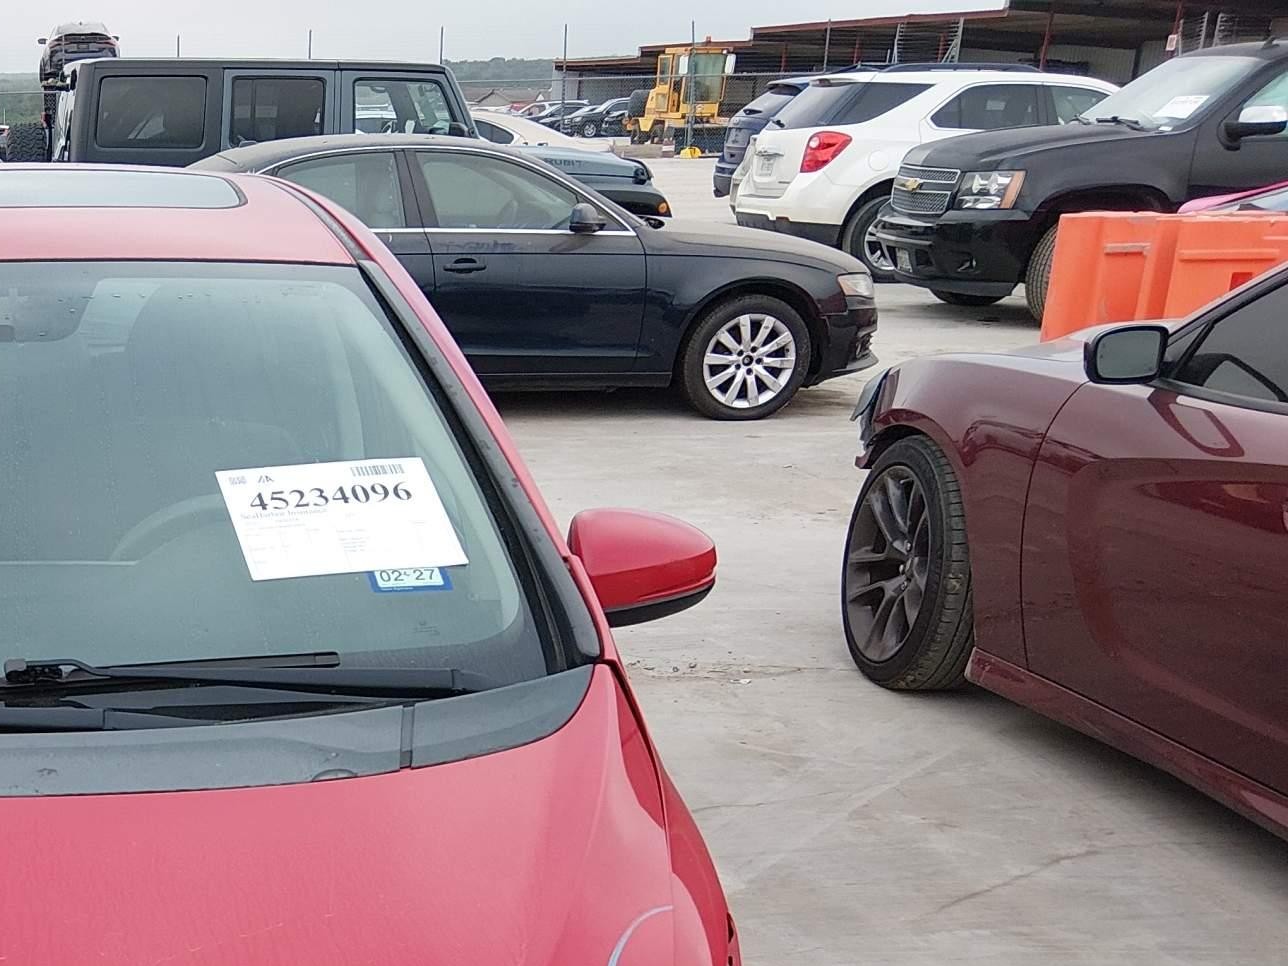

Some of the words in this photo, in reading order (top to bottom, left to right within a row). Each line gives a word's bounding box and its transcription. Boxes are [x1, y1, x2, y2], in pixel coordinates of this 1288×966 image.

[250, 481, 413, 511] 45234096
[379, 569, 404, 583] 02
[412, 568, 435, 581] 27
